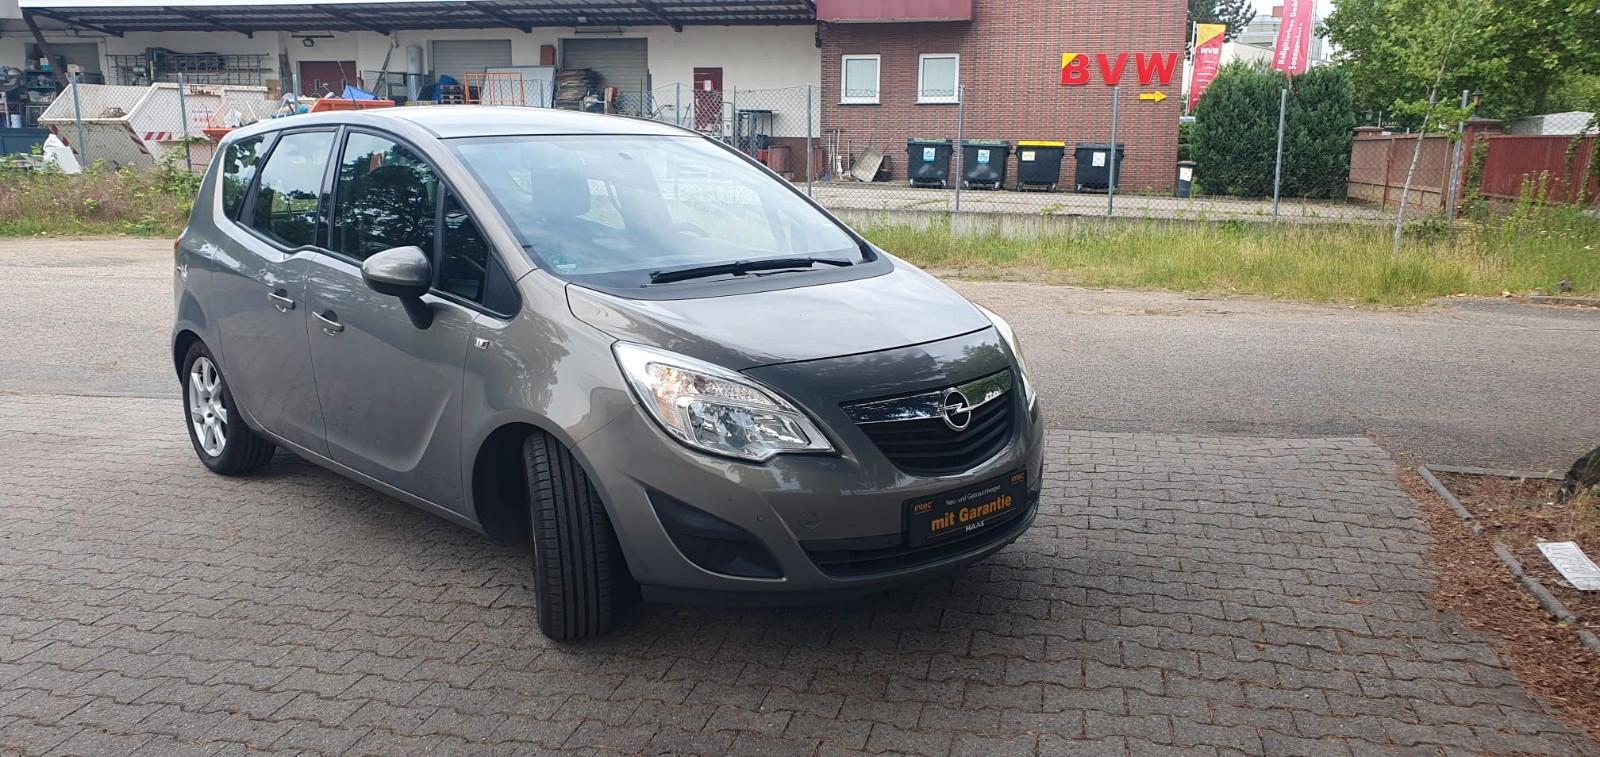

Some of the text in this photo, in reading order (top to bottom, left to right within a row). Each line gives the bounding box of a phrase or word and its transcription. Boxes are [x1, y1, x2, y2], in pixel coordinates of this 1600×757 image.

[1060, 52, 1179, 86] BVW
[931, 494, 1012, 531] mit Garantie
[965, 520, 985, 532] HAAS
